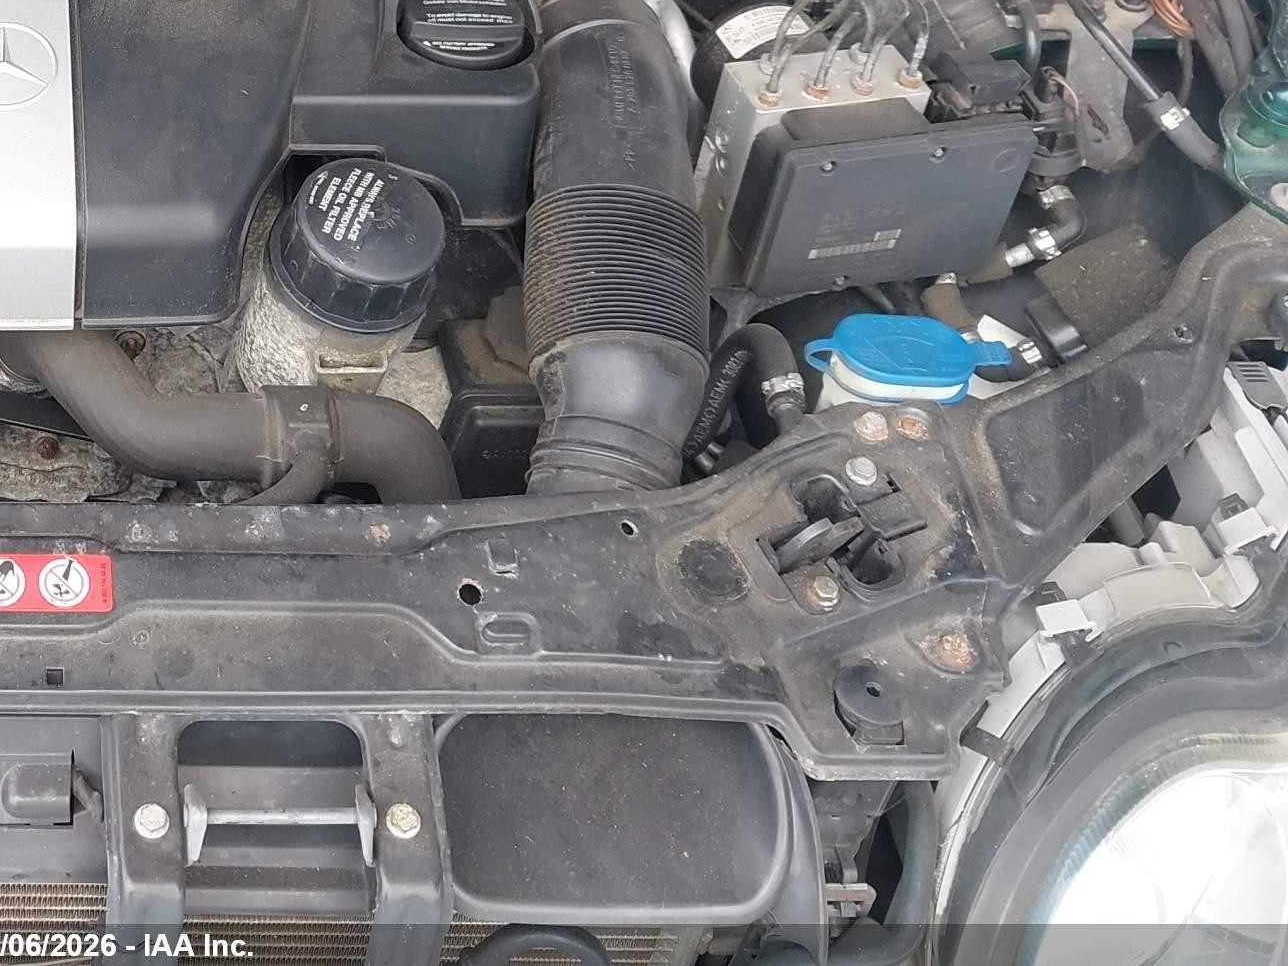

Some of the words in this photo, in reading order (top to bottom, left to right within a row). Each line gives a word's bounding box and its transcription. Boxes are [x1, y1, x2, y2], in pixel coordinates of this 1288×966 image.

[341, 168, 362, 193] FLEECE
[360, 172, 375, 187] WITH
[365, 179, 385, 203] ALWAYS
[318, 177, 342, 212] ELEMENT
[334, 192, 347, 204] OIL
[321, 205, 341, 234] FILTER
[333, 197, 359, 241] APPROVED
[347, 202, 372, 242] REPLACE
